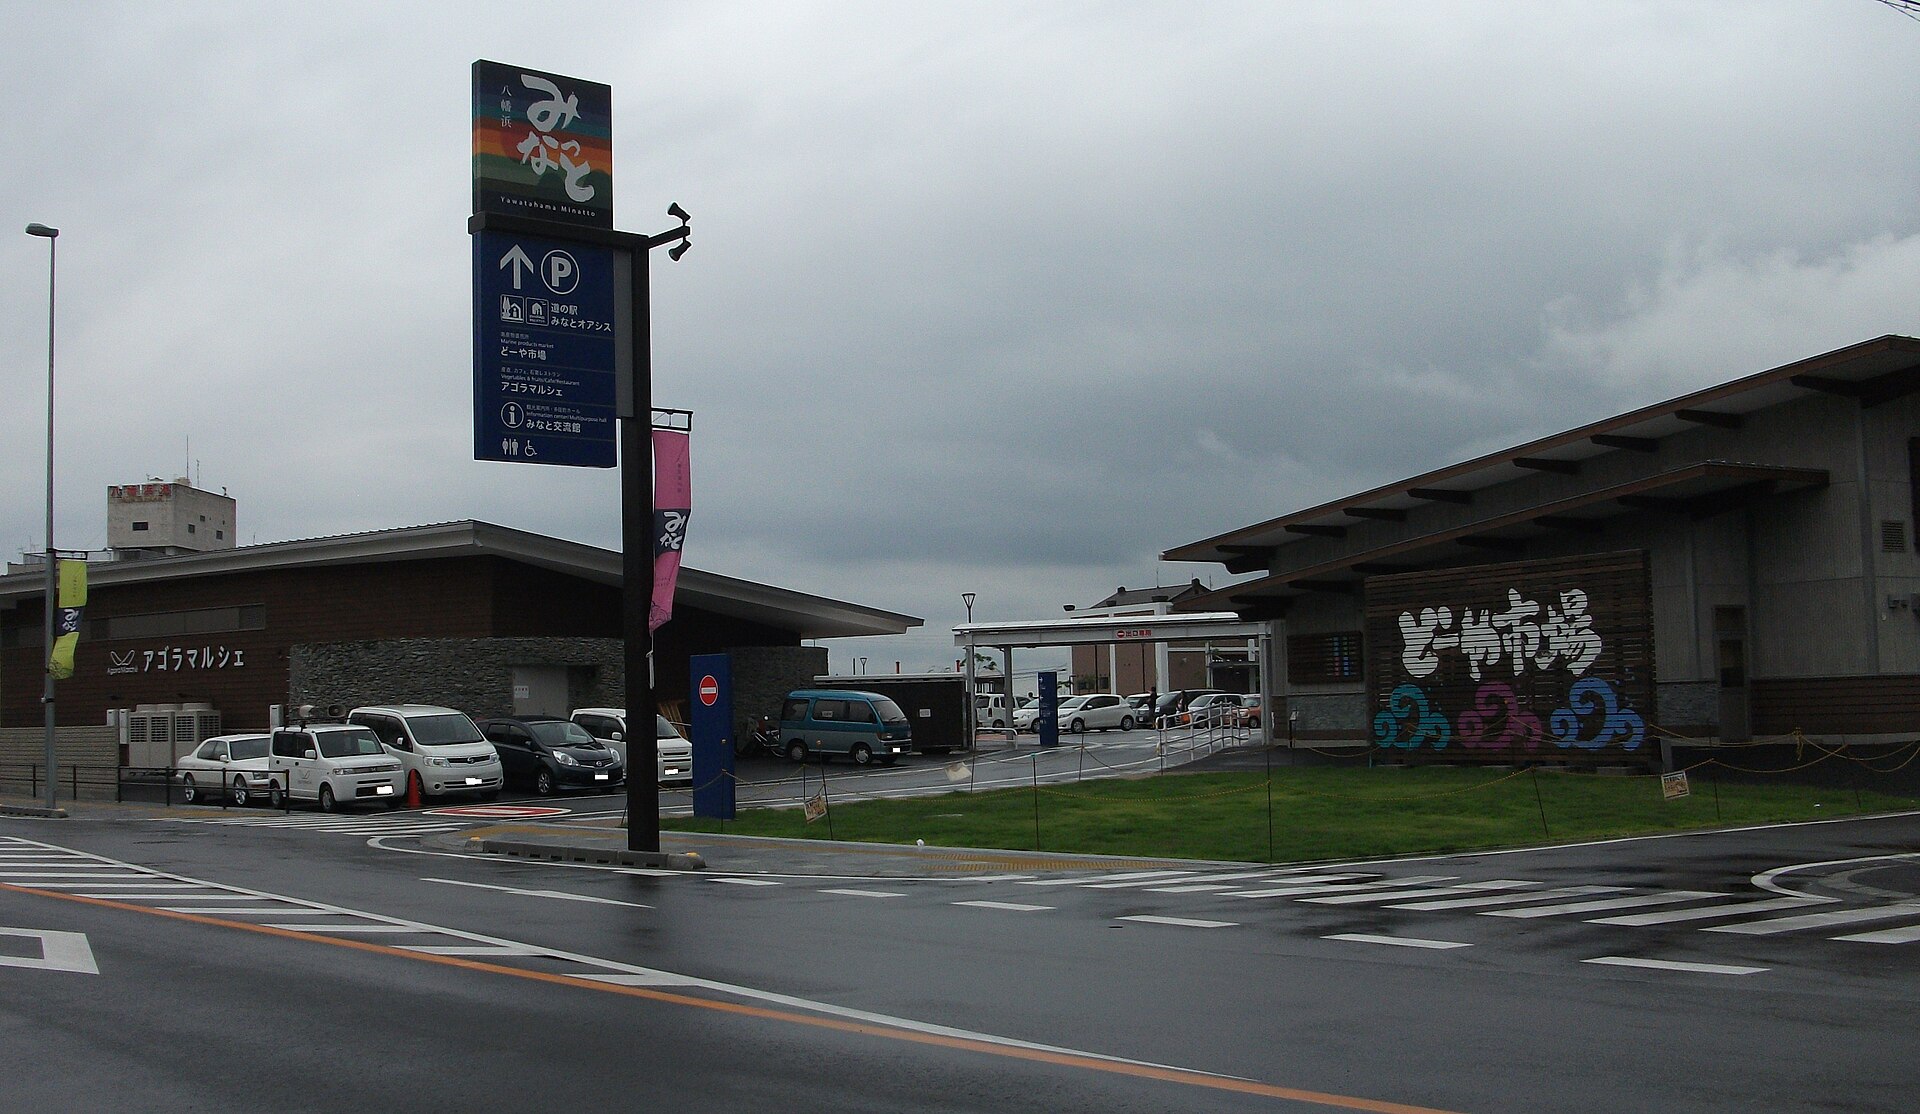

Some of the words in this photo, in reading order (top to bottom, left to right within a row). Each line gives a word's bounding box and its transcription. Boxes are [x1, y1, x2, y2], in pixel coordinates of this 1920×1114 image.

[501, 85, 512, 128] 八幡浜
[501, 196, 557, 211] Yawatahama
[561, 205, 596, 217] Minatto
[551, 256, 572, 287] P
[551, 303, 578, 315] 道の駅
[551, 316, 612, 332] みなとオアシス
[501, 346, 547, 360] どーや市場
[501, 381, 563, 396] アゴラマルシェ
[526, 419, 581, 433] みなと交流館
[1398, 587, 1602, 681] どーや市場
[143, 645, 244, 672] アゴラマルシェ
